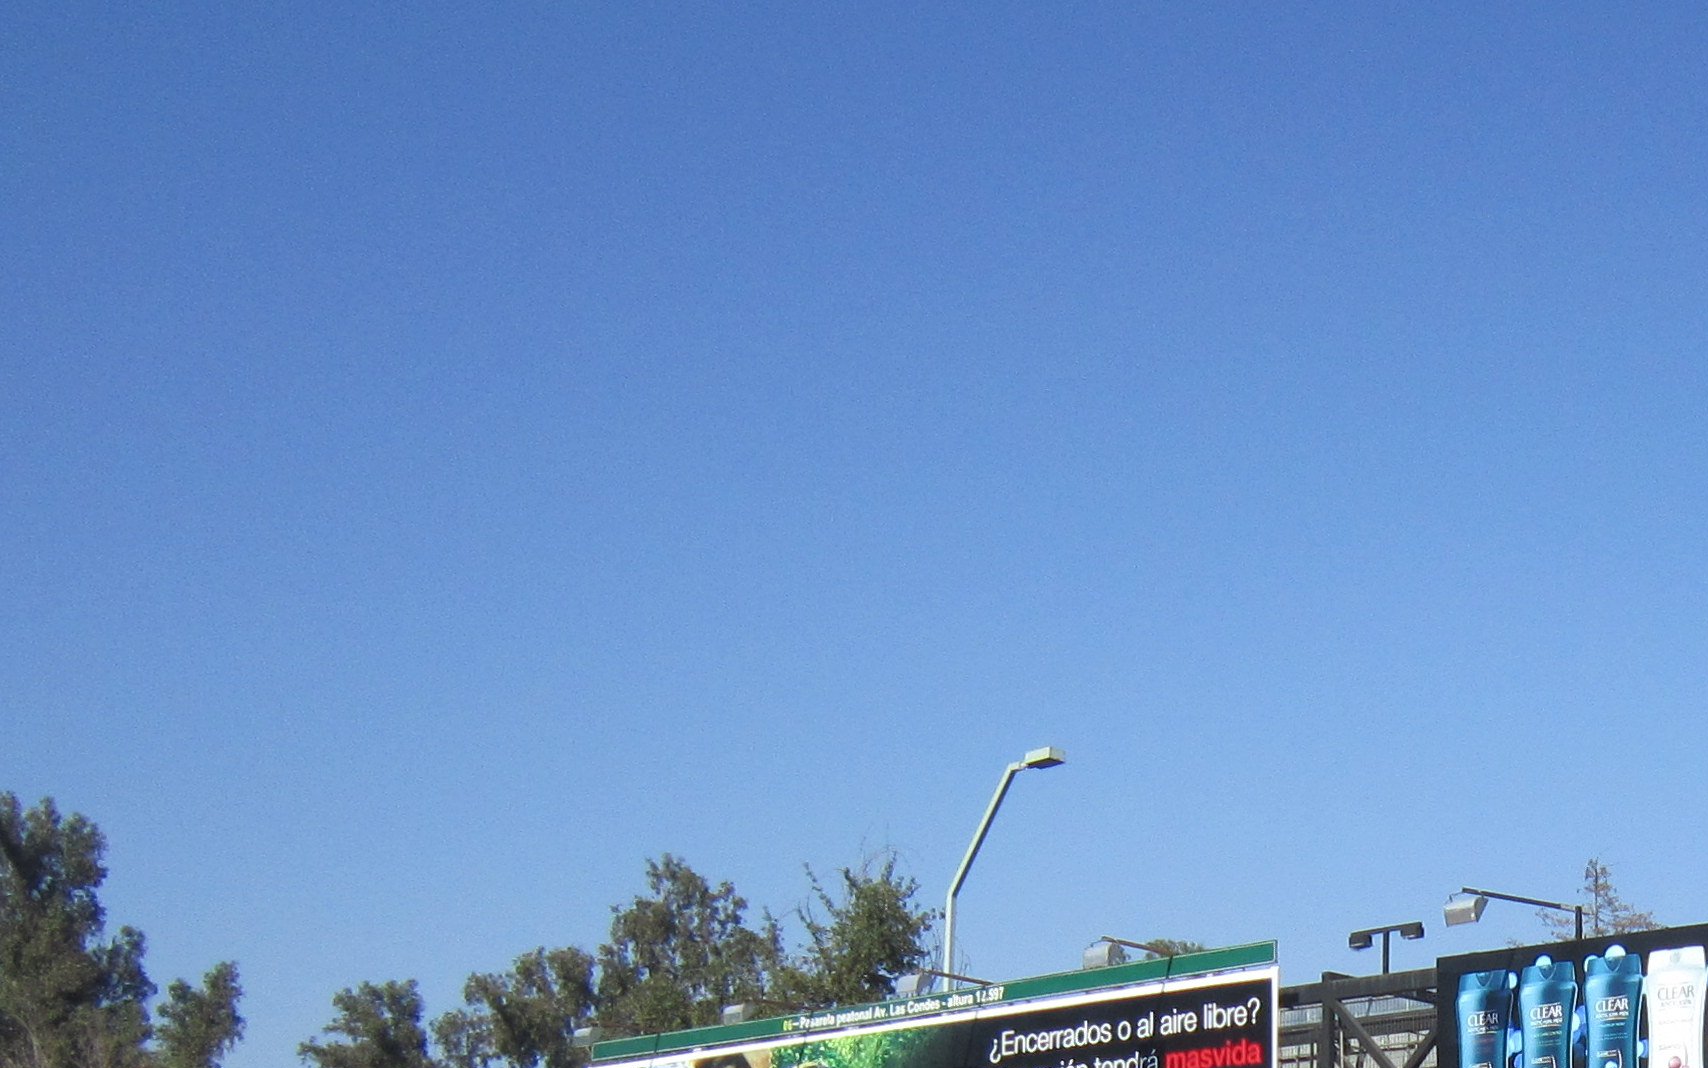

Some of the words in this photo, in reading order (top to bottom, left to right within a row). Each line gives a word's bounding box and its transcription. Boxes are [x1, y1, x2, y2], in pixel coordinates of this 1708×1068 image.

[1657, 985, 1695, 1000] CLEAR
[836, 1007, 872, 1027] peatonal
[873, 1006, 888, 1018] Av.
[890, 1003, 906, 1016] Las
[907, 998, 941, 1013] Condes
[947, 993, 973, 1007] altura
[1530, 1005, 1562, 1020] CLEAR
[1595, 998, 1628, 1012] CLEAR
[1468, 1012, 1499, 1027] CLEAR
[989, 1020, 1112, 1064] ¿Encerrados
[1117, 1020, 1131, 1041] o
[1137, 1011, 1155, 1039] al
[1160, 1007, 1198, 1035] aire
[1203, 996, 1261, 1030] libre?
